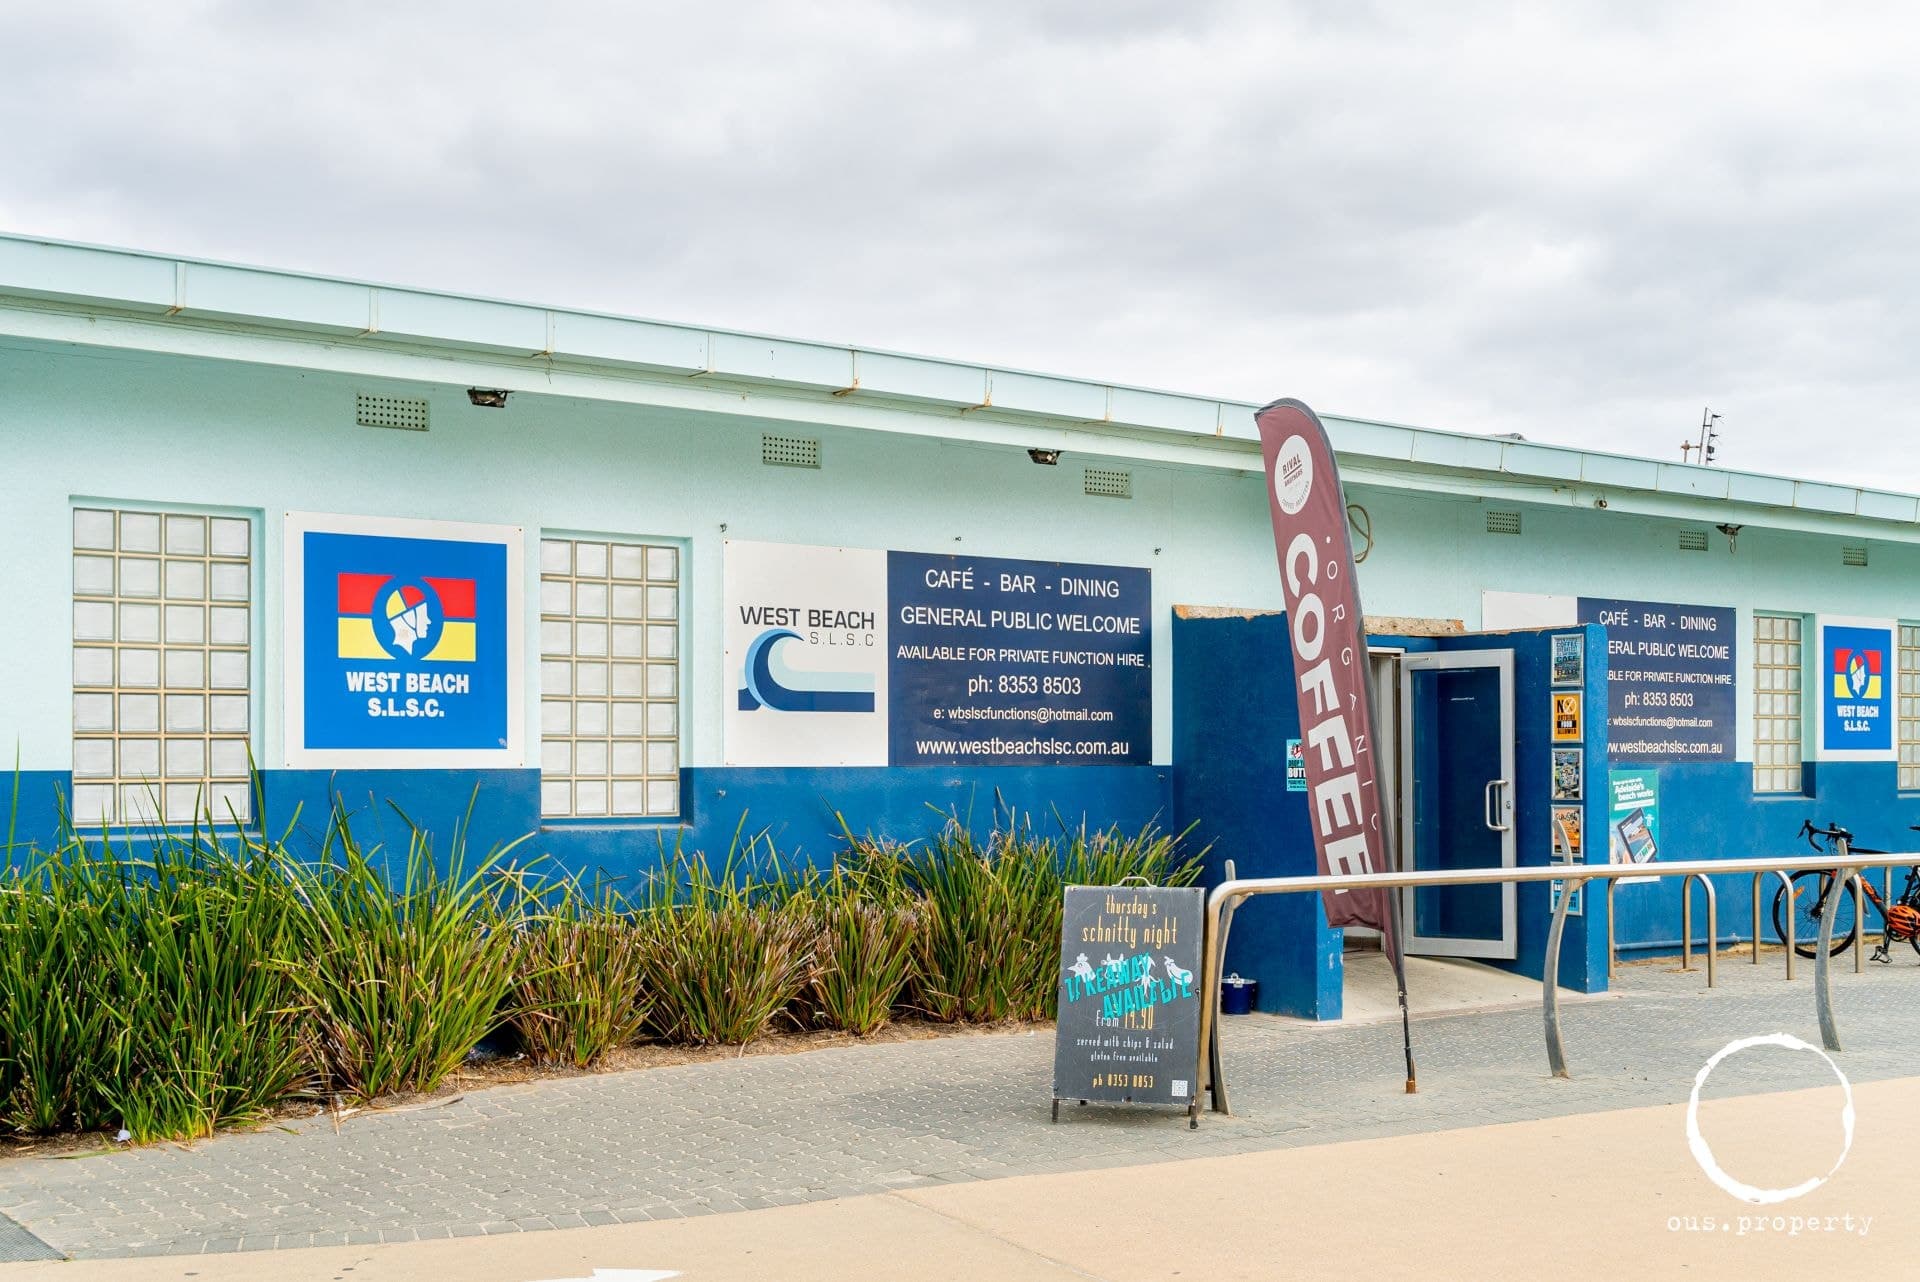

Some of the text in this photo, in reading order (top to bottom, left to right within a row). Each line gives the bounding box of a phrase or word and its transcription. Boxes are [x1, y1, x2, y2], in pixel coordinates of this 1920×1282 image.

[1282, 453, 1302, 475] RIVAL
[925, 567, 975, 590] CAFÉ
[1000, 574, 1036, 593] BAR
[1061, 577, 1120, 598] DINING
[740, 605, 875, 630] WEST BEACH
[901, 606, 1140, 634] GENERAL PUBLIC WELCOME
[1599, 609, 1629, 626] CAFÉ
[1643, 613, 1666, 628] BAR
[1680, 615, 1717, 631] DINING
[810, 631, 873, 647] S.L.S.C
[897, 645, 966, 661] AVAILABLE
[969, 647, 996, 662] FOR
[999, 648, 1049, 664] PRIVATE
[1053, 651, 1114, 666] FUNCTION
[1608, 640, 1729, 660] ERAL PUBLIC WELCOME
[346, 671, 469, 694] WEST BEACH
[968, 674, 1081, 696] ph: 8353 8503
[1625, 670, 1645, 682] FOR
[1643, 671, 1674, 683] PRIVATE
[1675, 672, 1713, 684] FUNCTION
[368, 697, 445, 718] S.L.S.C.
[1624, 691, 1694, 708] ph: 8353 8503
[933, 706, 1113, 723] e: wbslscfunctions@hotmail.com
[1285, 533, 1374, 895] COFFEE
[1837, 705, 1879, 718] WEST BEACH
[1613, 716, 1713, 729] wbslscfunctions@hotmail.com
[1844, 720, 1871, 732] S.L.S.C.
[916, 737, 1129, 755] www.westbeachslsc.com.au
[1082, 915, 1177, 949] schnitty night
[1077, 1035, 1100, 1047] served
[1104, 1036, 1119, 1047] with
[1123, 1036, 1142, 1050] chips
[1153, 1037, 1174, 1049] salad
[1093, 1074, 1103, 1088] ph
